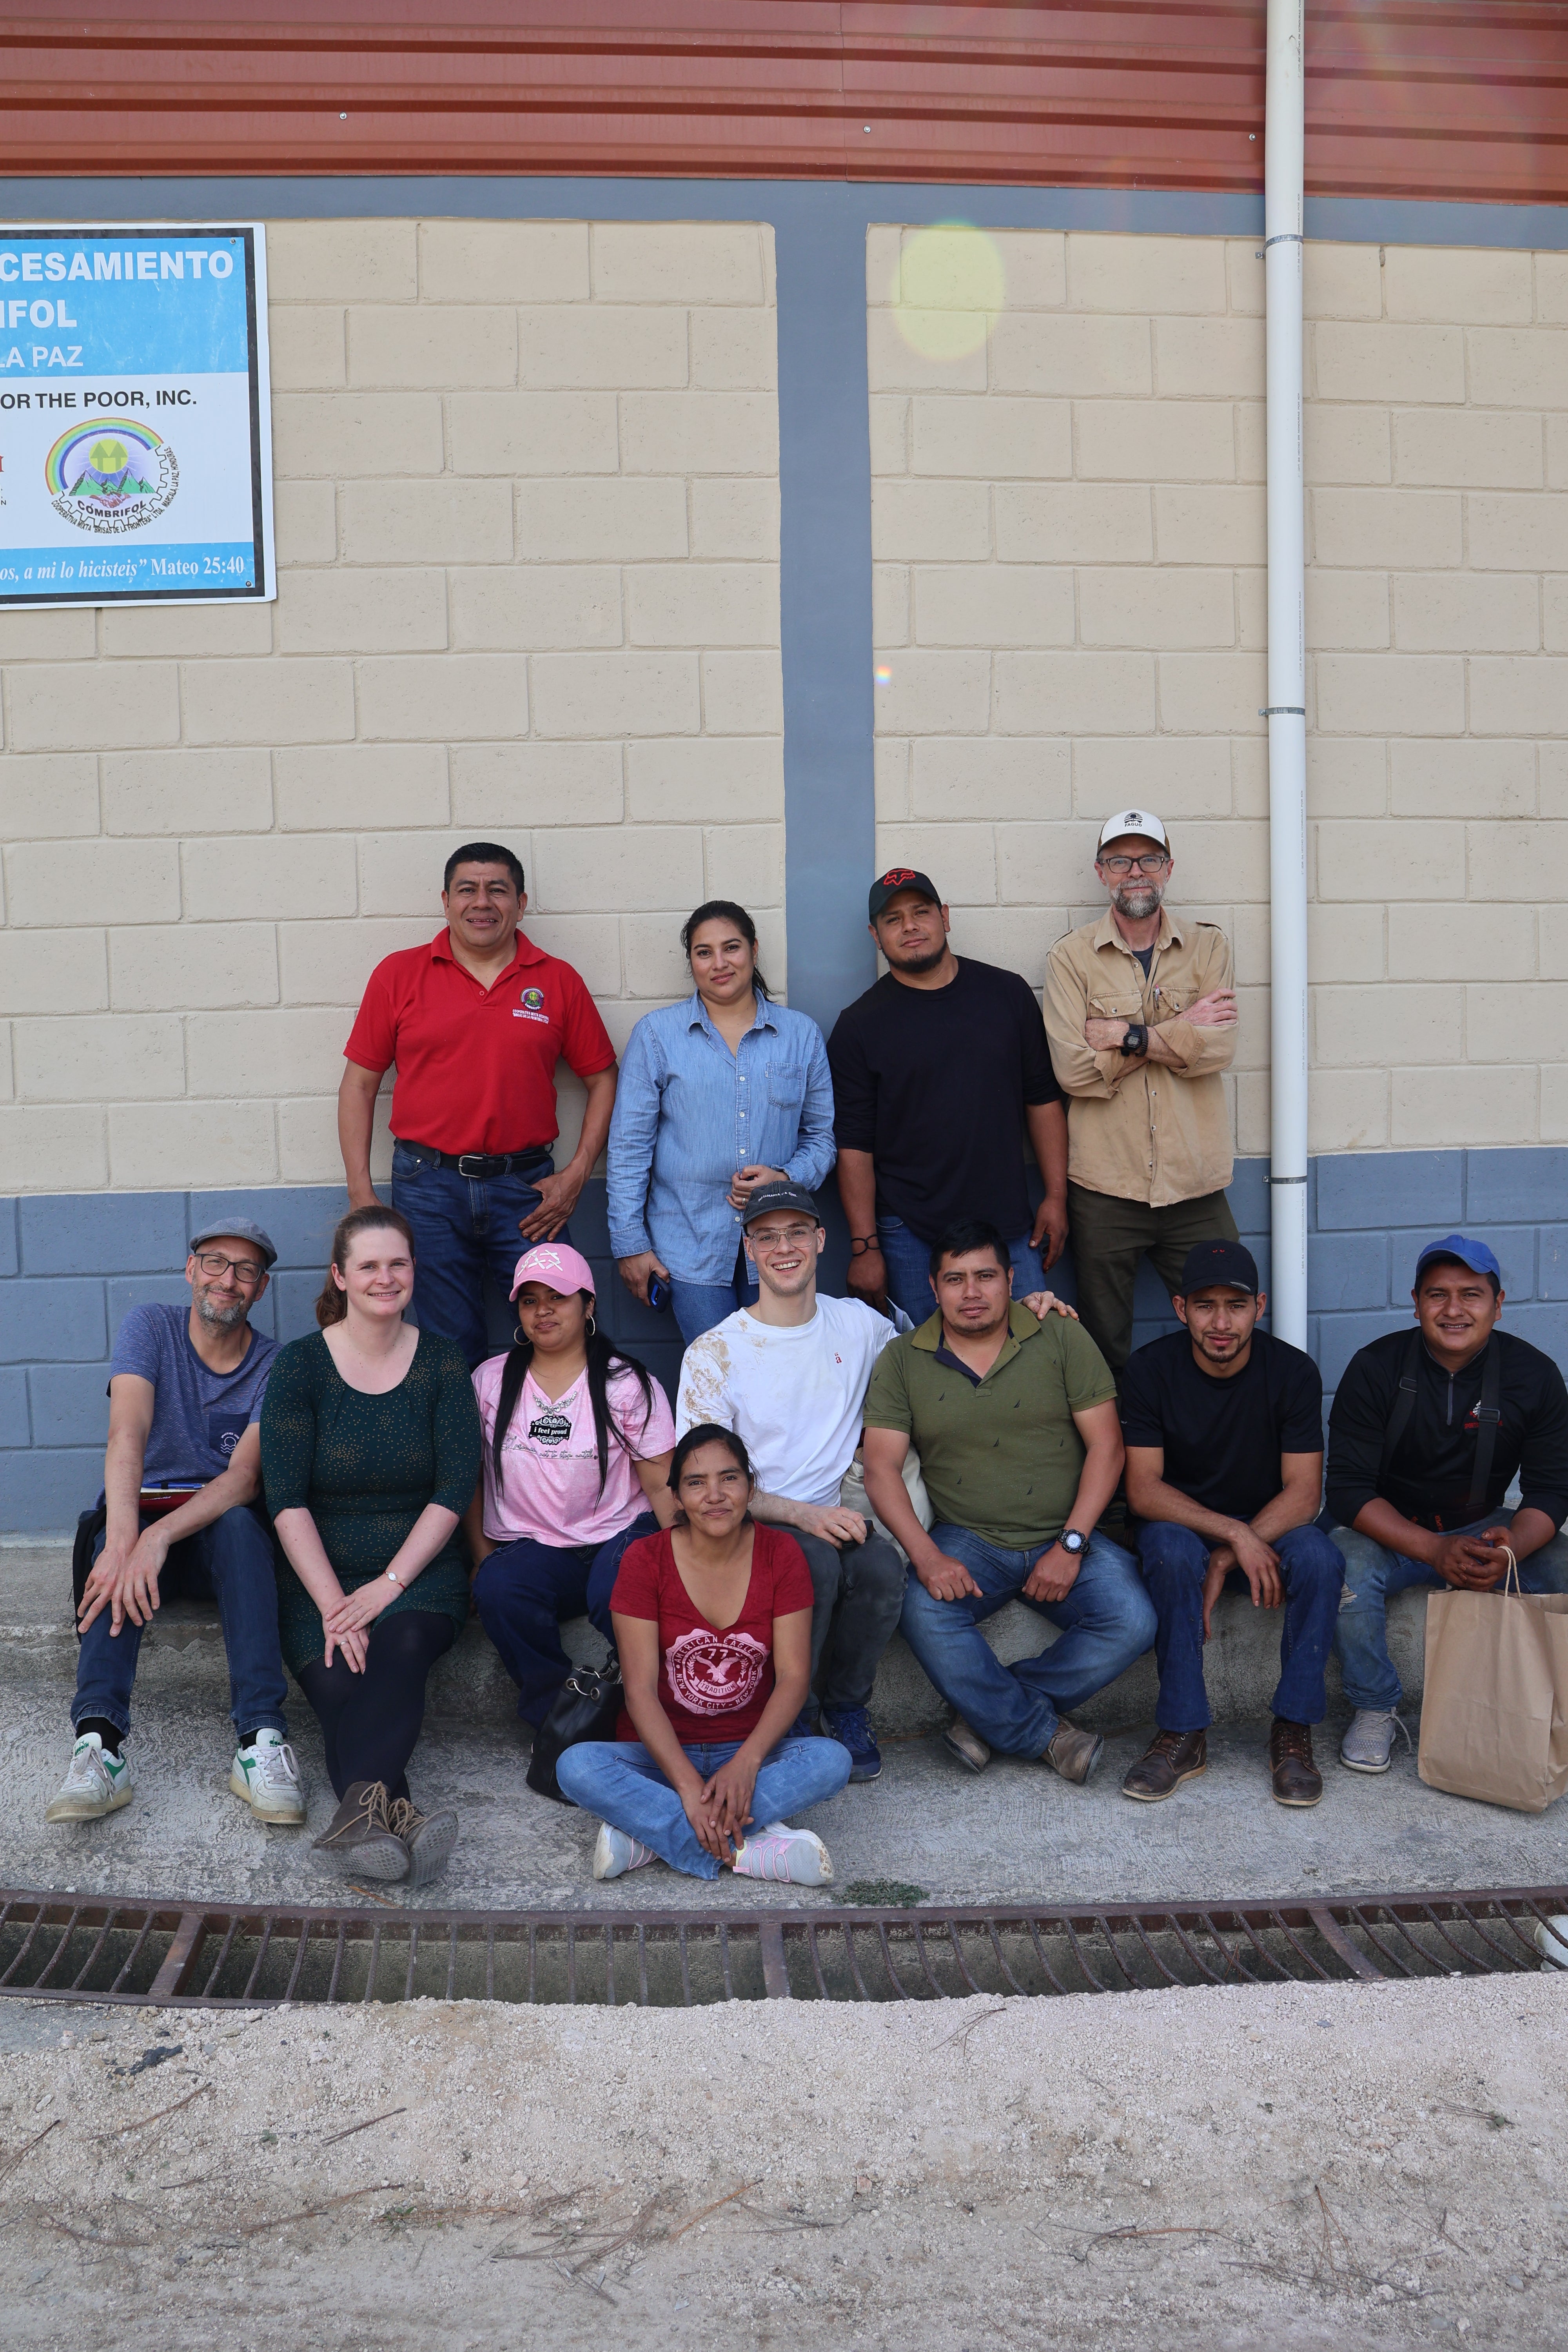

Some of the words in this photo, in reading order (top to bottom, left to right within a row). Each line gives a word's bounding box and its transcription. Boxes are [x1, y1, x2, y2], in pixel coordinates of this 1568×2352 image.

[0, 250, 233, 281] CESAMIENTO
[33, 346, 83, 367] PAZ
[0, 394, 31, 409] OR
[35, 393, 76, 408] THE
[84, 391, 150, 409] POOR,
[156, 390, 197, 405] INC.
[51, 500, 78, 525] COOPERATIVA
[76, 520, 92, 532] MIXTA
[78, 500, 146, 517] COMBRIFOL
[0, 568, 18, 583] os,
[24, 567, 33, 579] a
[37, 561, 56, 579] mi
[60, 561, 74, 578] lo
[151, 558, 198, 575] Mateo
[203, 556, 244, 574] 25:40
[674, 1636, 718, 1663] AMERICAN
[724, 1638, 755, 1653] EAGLE
[708, 1648, 728, 1659] 77
[676, 1673, 686, 1690] NEW
[684, 1690, 704, 1706] YORK
[735, 1690, 749, 1705] NEW
[701, 1682, 737, 1694] TRADITION
